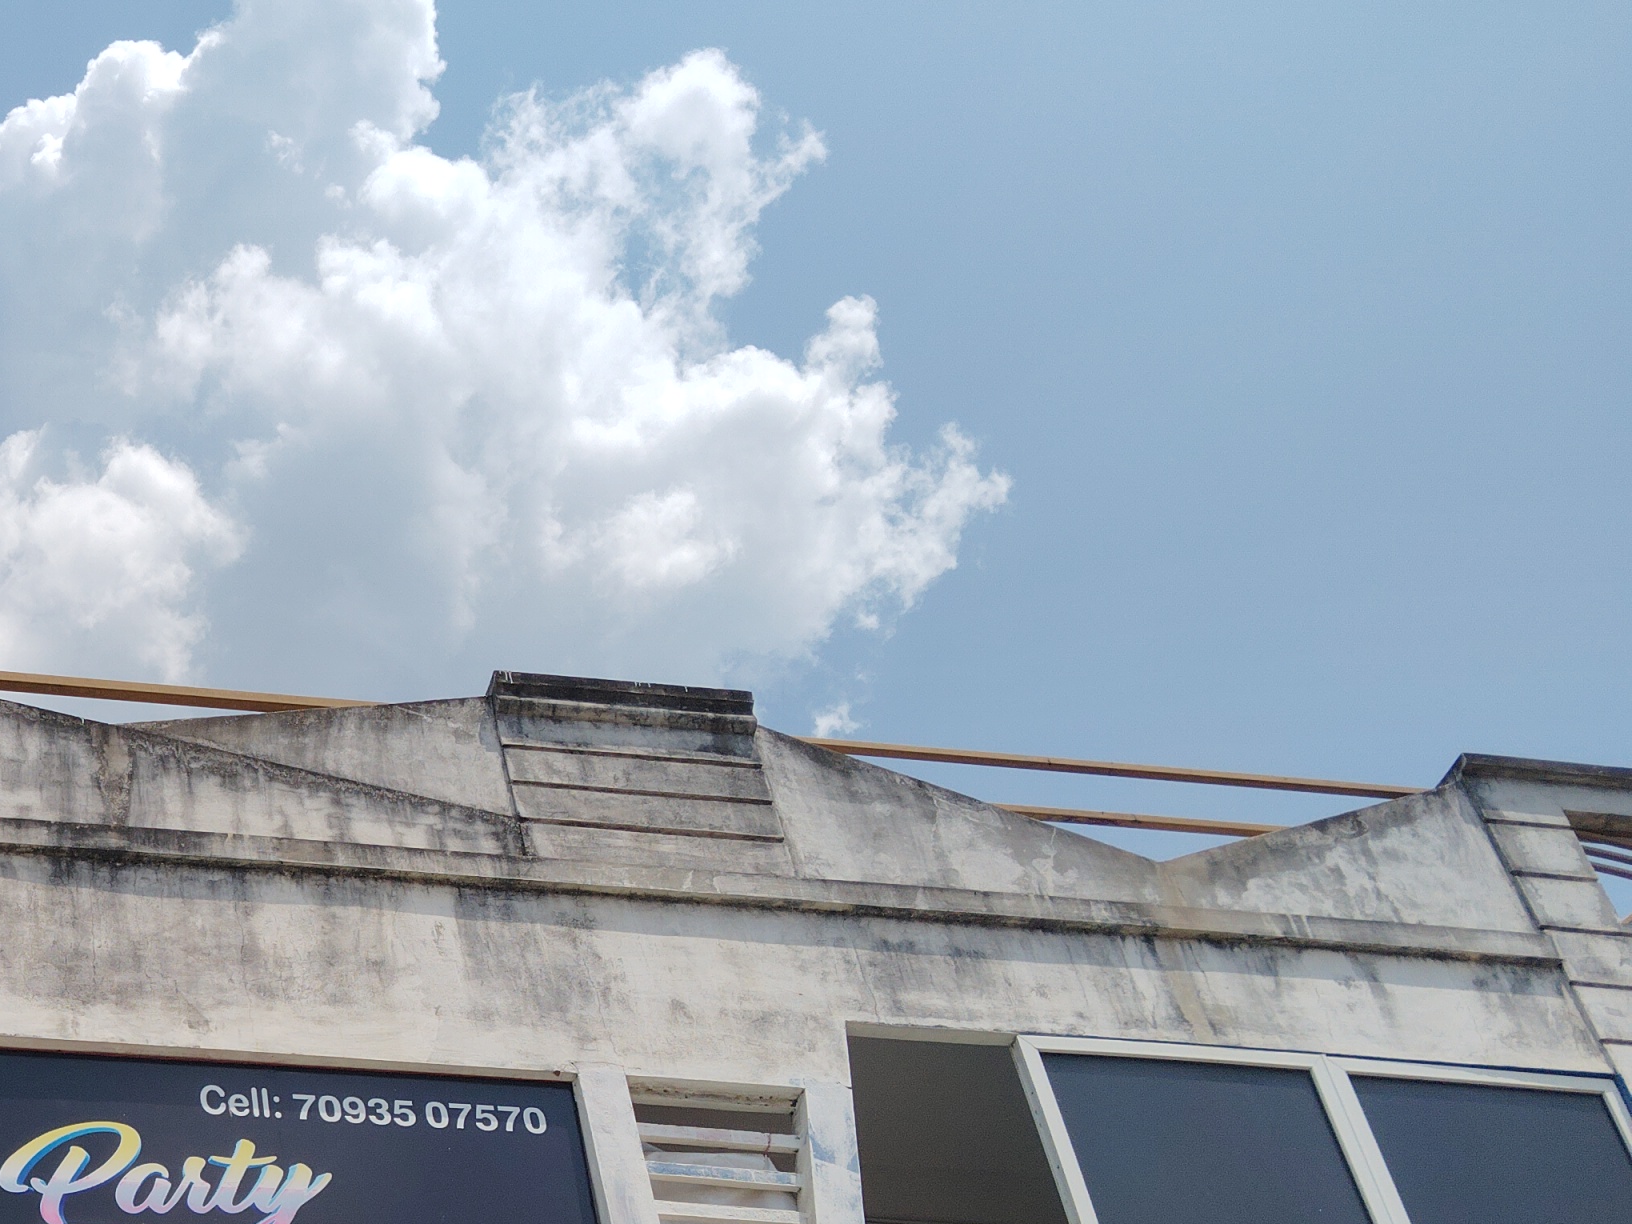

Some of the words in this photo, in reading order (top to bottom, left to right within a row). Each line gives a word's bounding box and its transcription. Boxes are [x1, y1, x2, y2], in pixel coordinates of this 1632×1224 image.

[200, 1084, 282, 1119] Cell:
[292, 1093, 415, 1128] 70935
[425, 1101, 547, 1135] 07570
